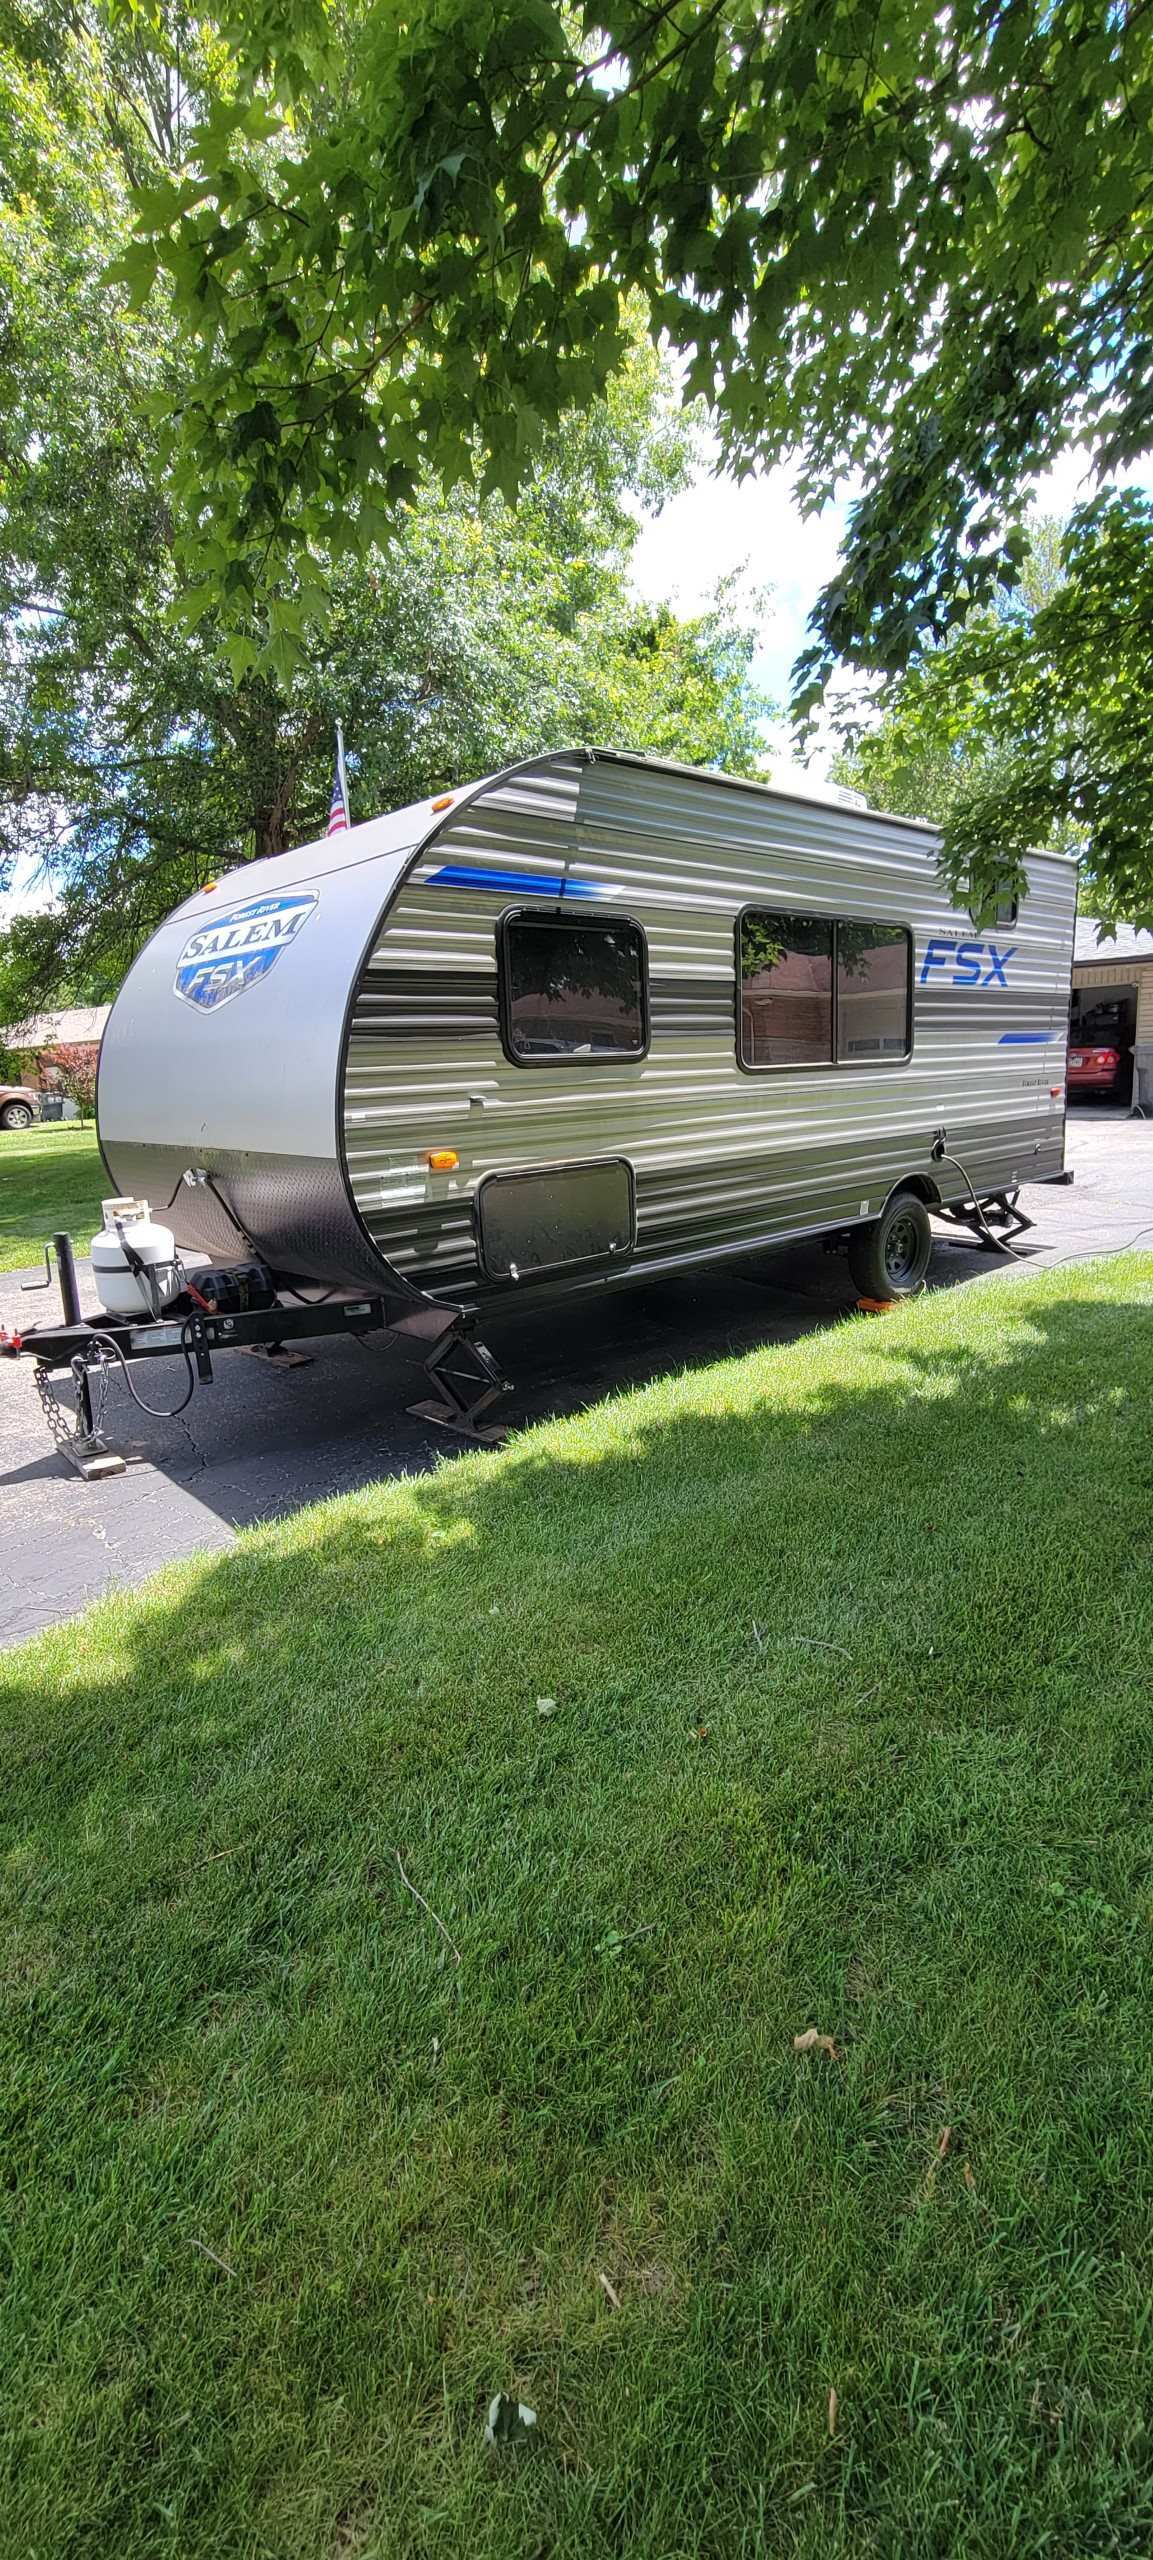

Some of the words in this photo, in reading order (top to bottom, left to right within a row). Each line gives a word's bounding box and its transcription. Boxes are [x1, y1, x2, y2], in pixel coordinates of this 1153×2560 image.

[183, 911, 306, 960] SALEM
[186, 956, 262, 994] FSX
[920, 939, 1018, 988] FSX
